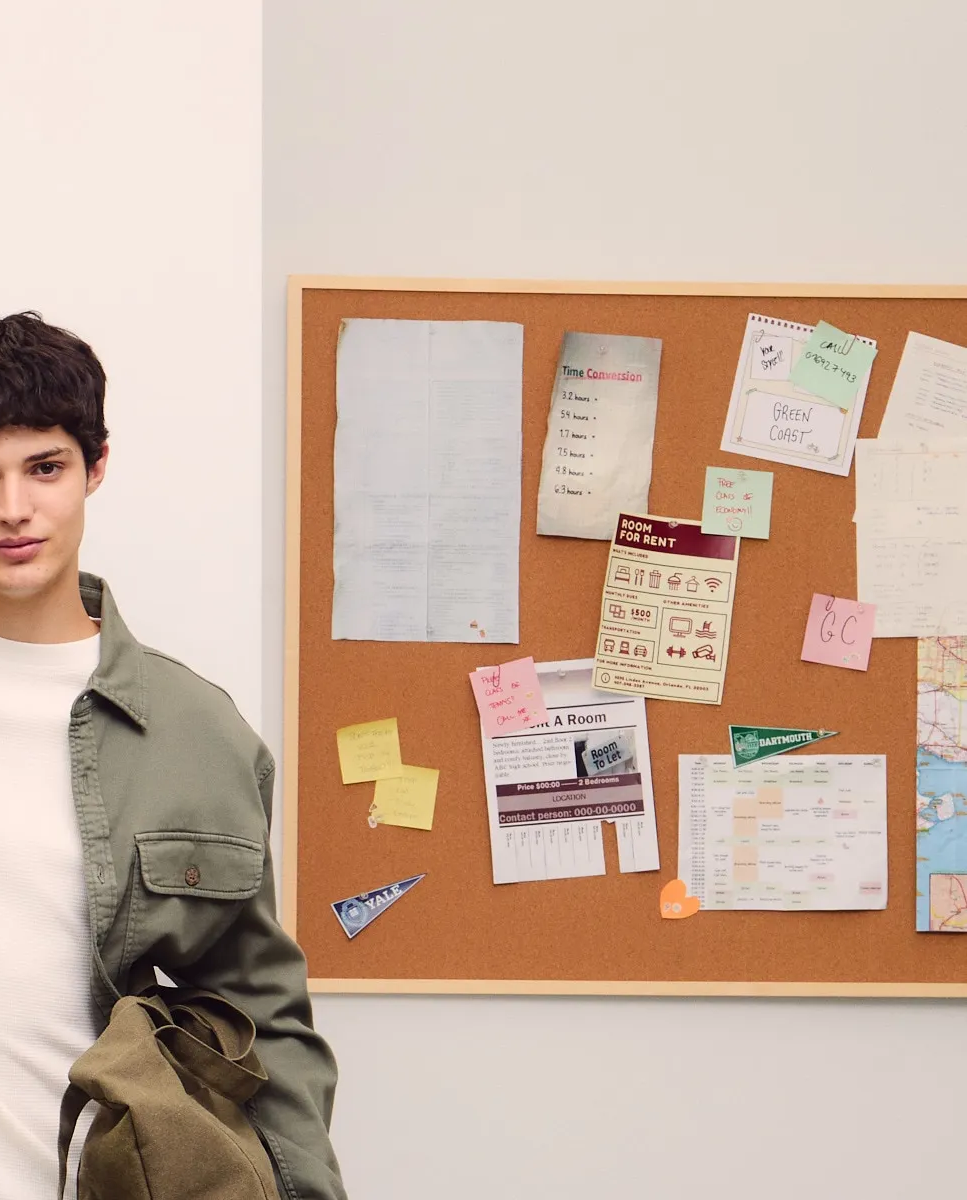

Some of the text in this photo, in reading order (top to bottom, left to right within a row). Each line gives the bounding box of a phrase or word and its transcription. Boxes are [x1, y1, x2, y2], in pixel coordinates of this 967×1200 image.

[562, 366, 642, 382] Time Conversion
[574, 394, 590, 402] hours
[774, 402, 813, 422] GREEN
[770, 425, 813, 444] COAST
[569, 450, 585, 458] hours
[569, 468, 584, 476] hours
[622, 518, 652, 533] ROOM
[619, 530, 677, 548] FOR RENT
[605, 590, 625, 598] MONTHLY
[631, 608, 651, 617] $500
[602, 625, 640, 635] TRANSPORTATION
[619, 662, 652, 670] INFORMATION
[554, 715, 563, 726] A
[568, 713, 607, 725] Room
[759, 733, 813, 747] DARTMOUTH
[591, 741, 618, 760] Room
[593, 750, 622, 770] To Let
[584, 777, 620, 785] Bedrooms
[553, 794, 586, 802] LOCATION
[499, 803, 636, 823] Contact person: 000-00-0000
[364, 884, 402, 909] YALE
